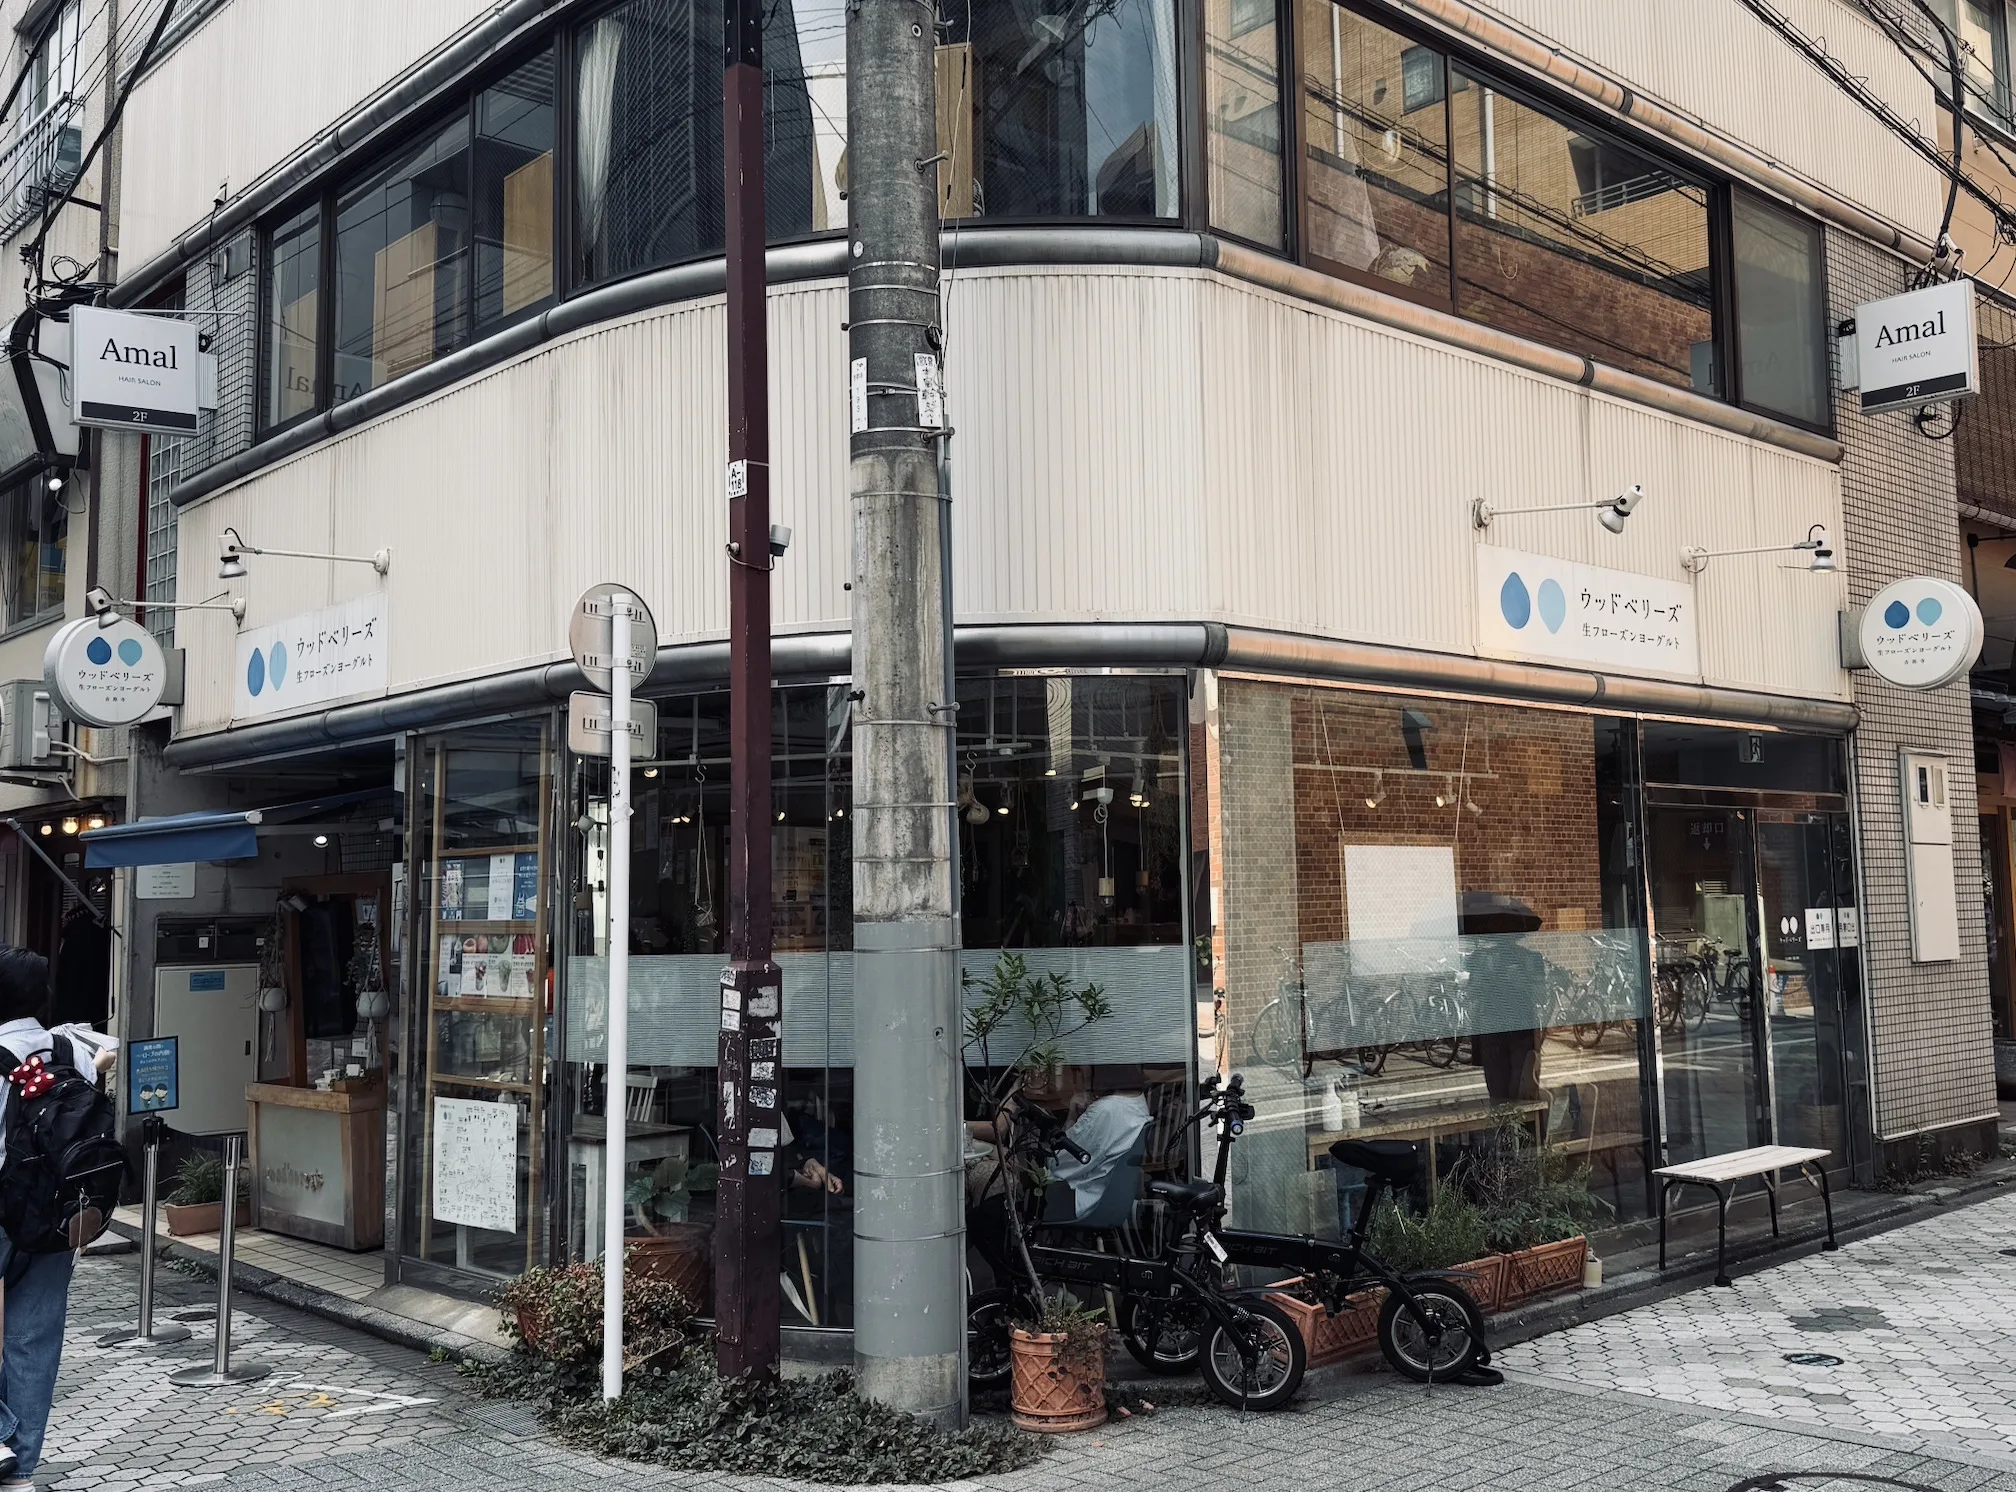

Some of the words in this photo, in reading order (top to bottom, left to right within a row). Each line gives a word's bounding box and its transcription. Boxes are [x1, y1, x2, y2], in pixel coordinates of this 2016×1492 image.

[1875, 310, 1946, 348] Amal
[99, 338, 178, 370] Amal
[1891, 354, 1909, 364] HAIR
[1909, 351, 1931, 361] SALON
[118, 375, 136, 384] HAIR
[137, 378, 161, 387] SALON
[1906, 385, 1920, 397] 2F
[132, 410, 149, 422] 2F
[732, 479, 741, 490] 118
[1580, 588, 1682, 623] ウッドベリーズ
[297, 616, 377, 659] ウッドベリーズ
[1582, 622, 1680, 650] 生フローズンヨーグルト
[1876, 630, 1956, 646] ウッドベリーズ
[78, 669, 154, 682] ウッドベリーズ
[296, 653, 373, 684] 生フローズンヨーグルト
[1689, 821, 1724, 835] 返却口
[1810, 923, 1831, 935] 出口専用
